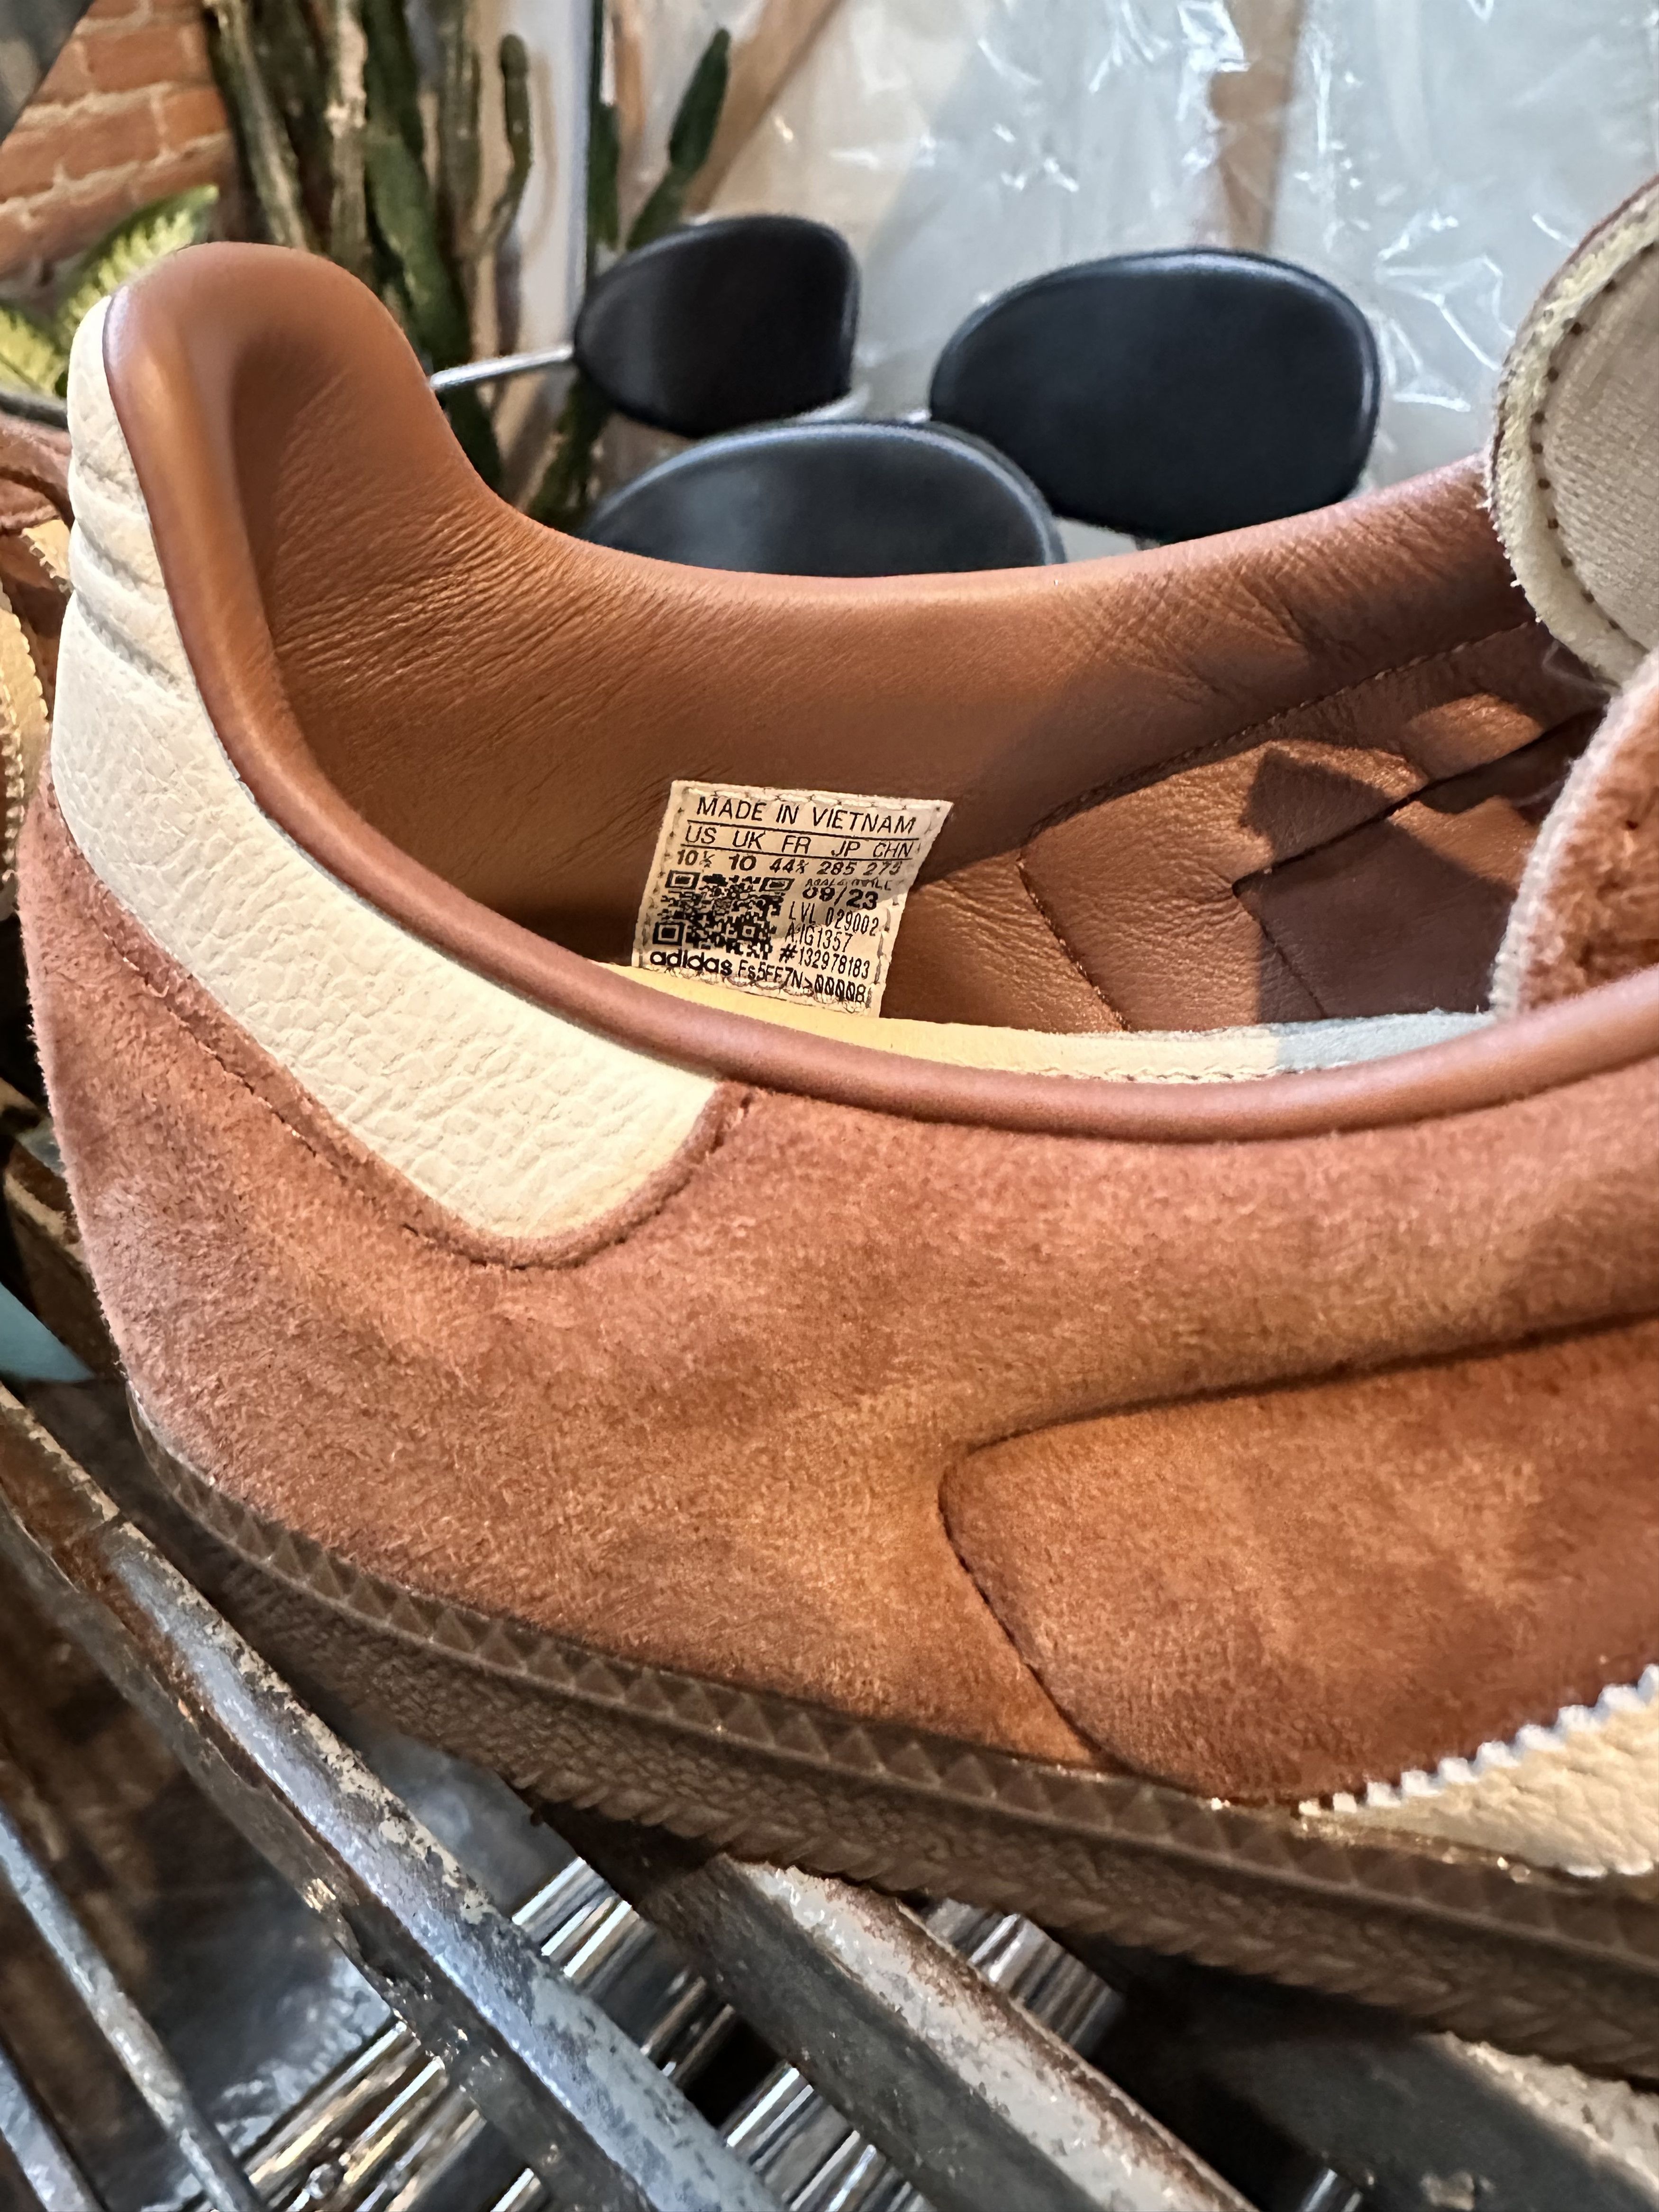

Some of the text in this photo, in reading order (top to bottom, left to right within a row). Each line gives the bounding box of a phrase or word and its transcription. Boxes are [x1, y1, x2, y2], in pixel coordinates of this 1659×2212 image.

[697, 796, 917, 834] MADE IN VIETNAM
[685, 825, 914, 858] US UK FR JP CHN
[729, 853, 757, 871] 10
[816, 861, 857, 875] 285
[788, 901, 879, 937] LVL 029002
[650, 948, 733, 976] adidas
